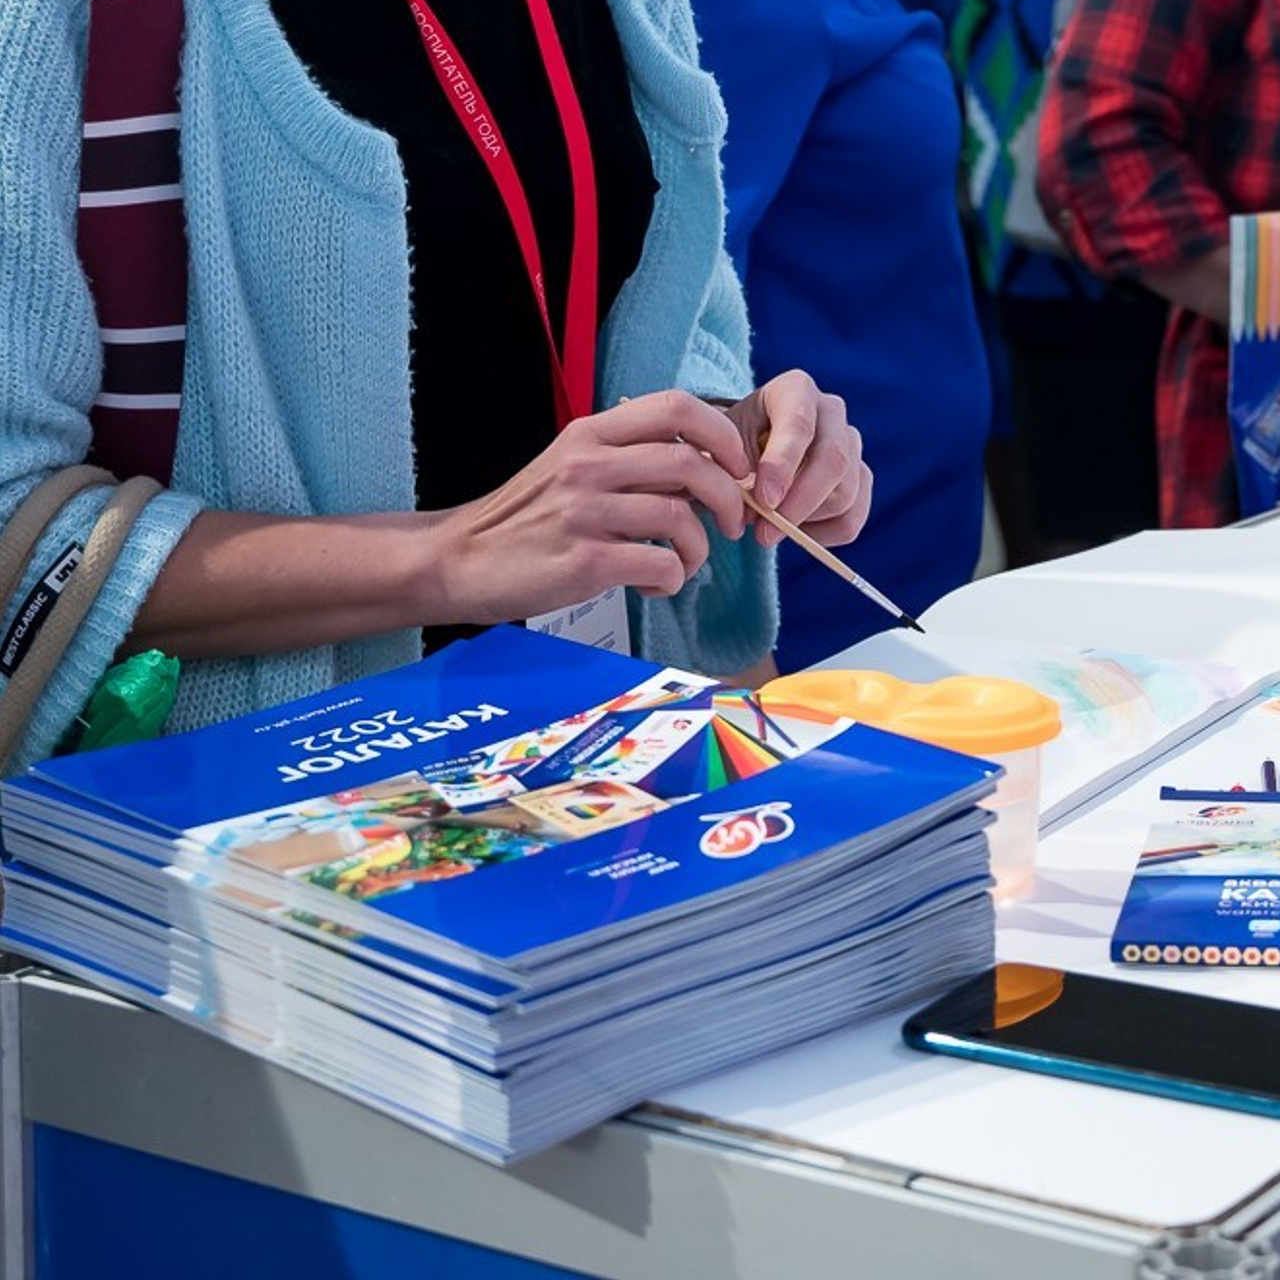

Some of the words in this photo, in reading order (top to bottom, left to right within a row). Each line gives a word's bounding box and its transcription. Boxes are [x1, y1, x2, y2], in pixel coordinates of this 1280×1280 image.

[410, 2, 477, 115] ВОСПИТАТЕЛЬ
[473, 114, 502, 158] ГОДА
[2, 636, 20, 667] BEST
[14, 592, 49, 639] CLASSIC
[276, 703, 509, 783] КАТАЛОГ
[290, 710, 415, 751] 2022
